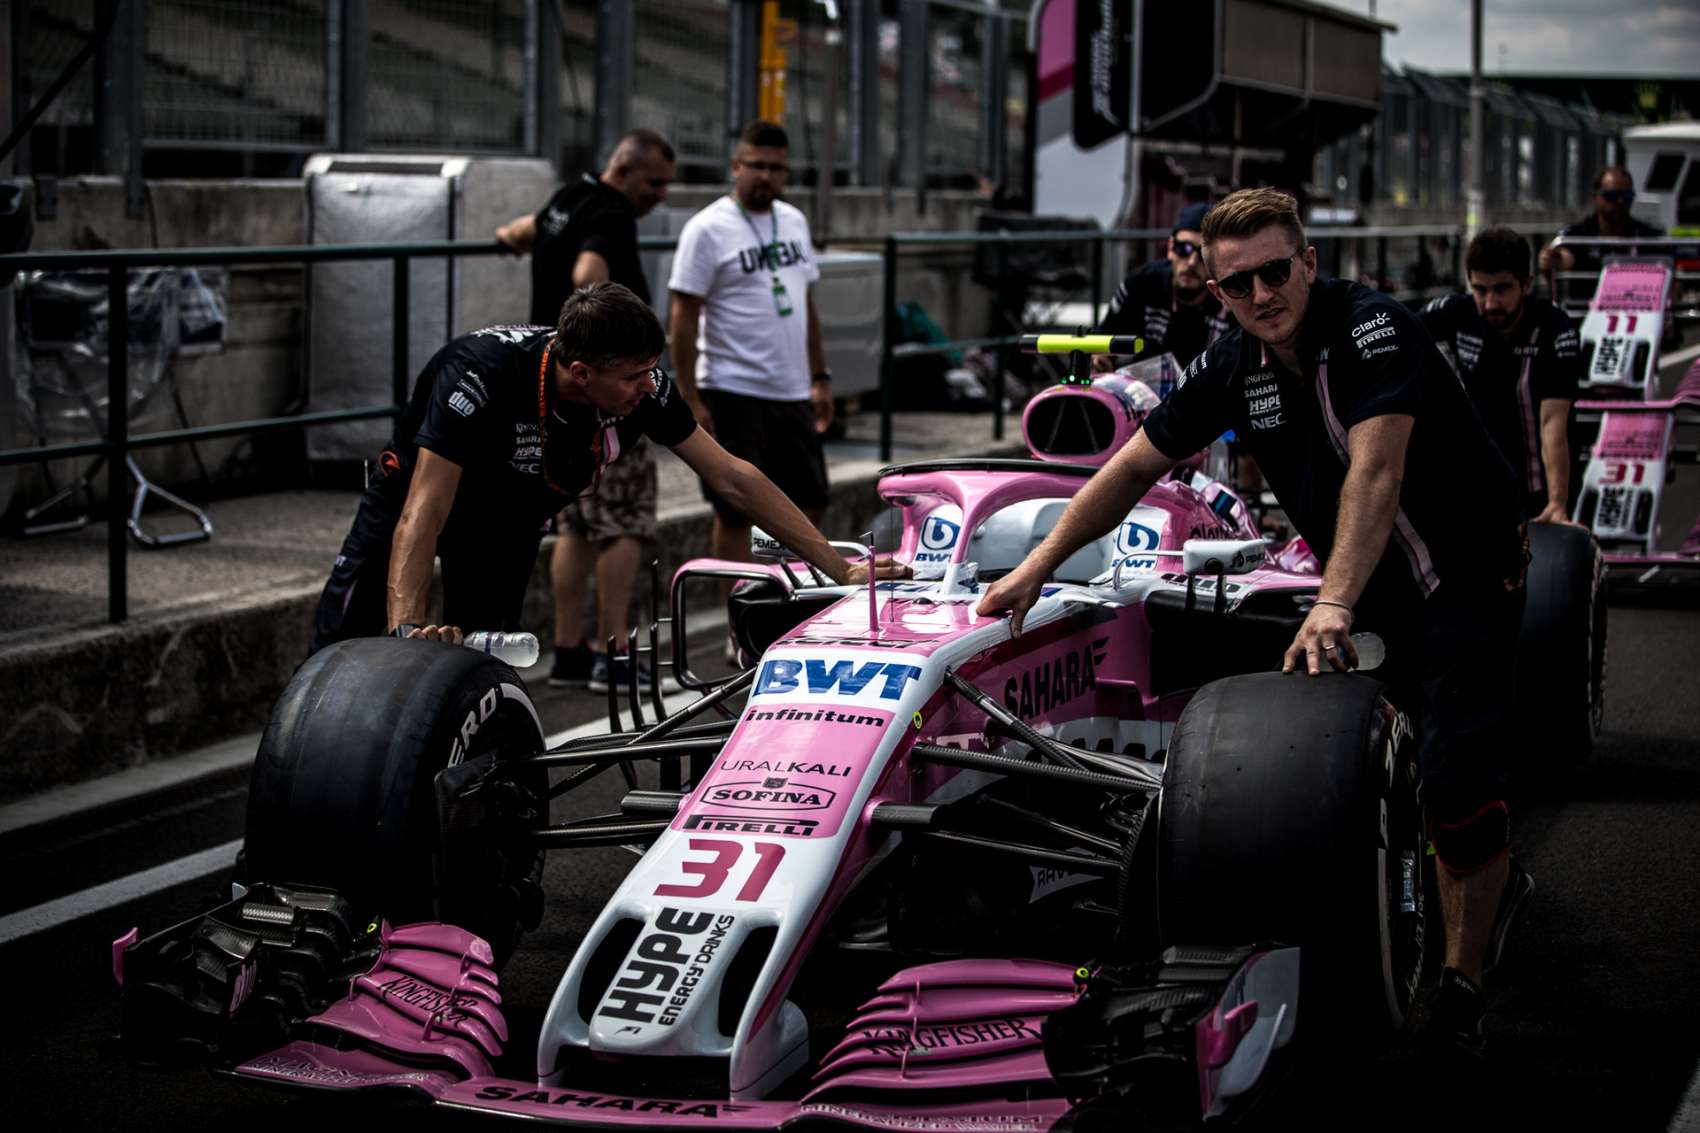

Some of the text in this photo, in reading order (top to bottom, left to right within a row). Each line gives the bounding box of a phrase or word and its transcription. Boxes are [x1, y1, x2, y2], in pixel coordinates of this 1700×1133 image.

[1352, 314, 1388, 337] Claro
[1607, 315, 1637, 334] 11
[1355, 326, 1396, 349] PIRELLI
[1249, 394, 1281, 412] HYPE
[1250, 413, 1288, 430] NEC
[1600, 464, 1644, 484] 31
[752, 659, 922, 700] BWT
[1004, 643, 1098, 720] SAHARA
[746, 709, 884, 727] infinitum
[720, 760, 852, 777] URALKALI
[712, 789, 821, 805] SOFINA
[682, 814, 819, 836] PIRELLI
[653, 838, 786, 902] 31
[598, 907, 715, 1023] HYPE
[658, 914, 735, 1026] ENERGY DRINKS
[862, 1018, 1044, 1058] KINGFISHER
[475, 1085, 719, 1118] SAHARA
